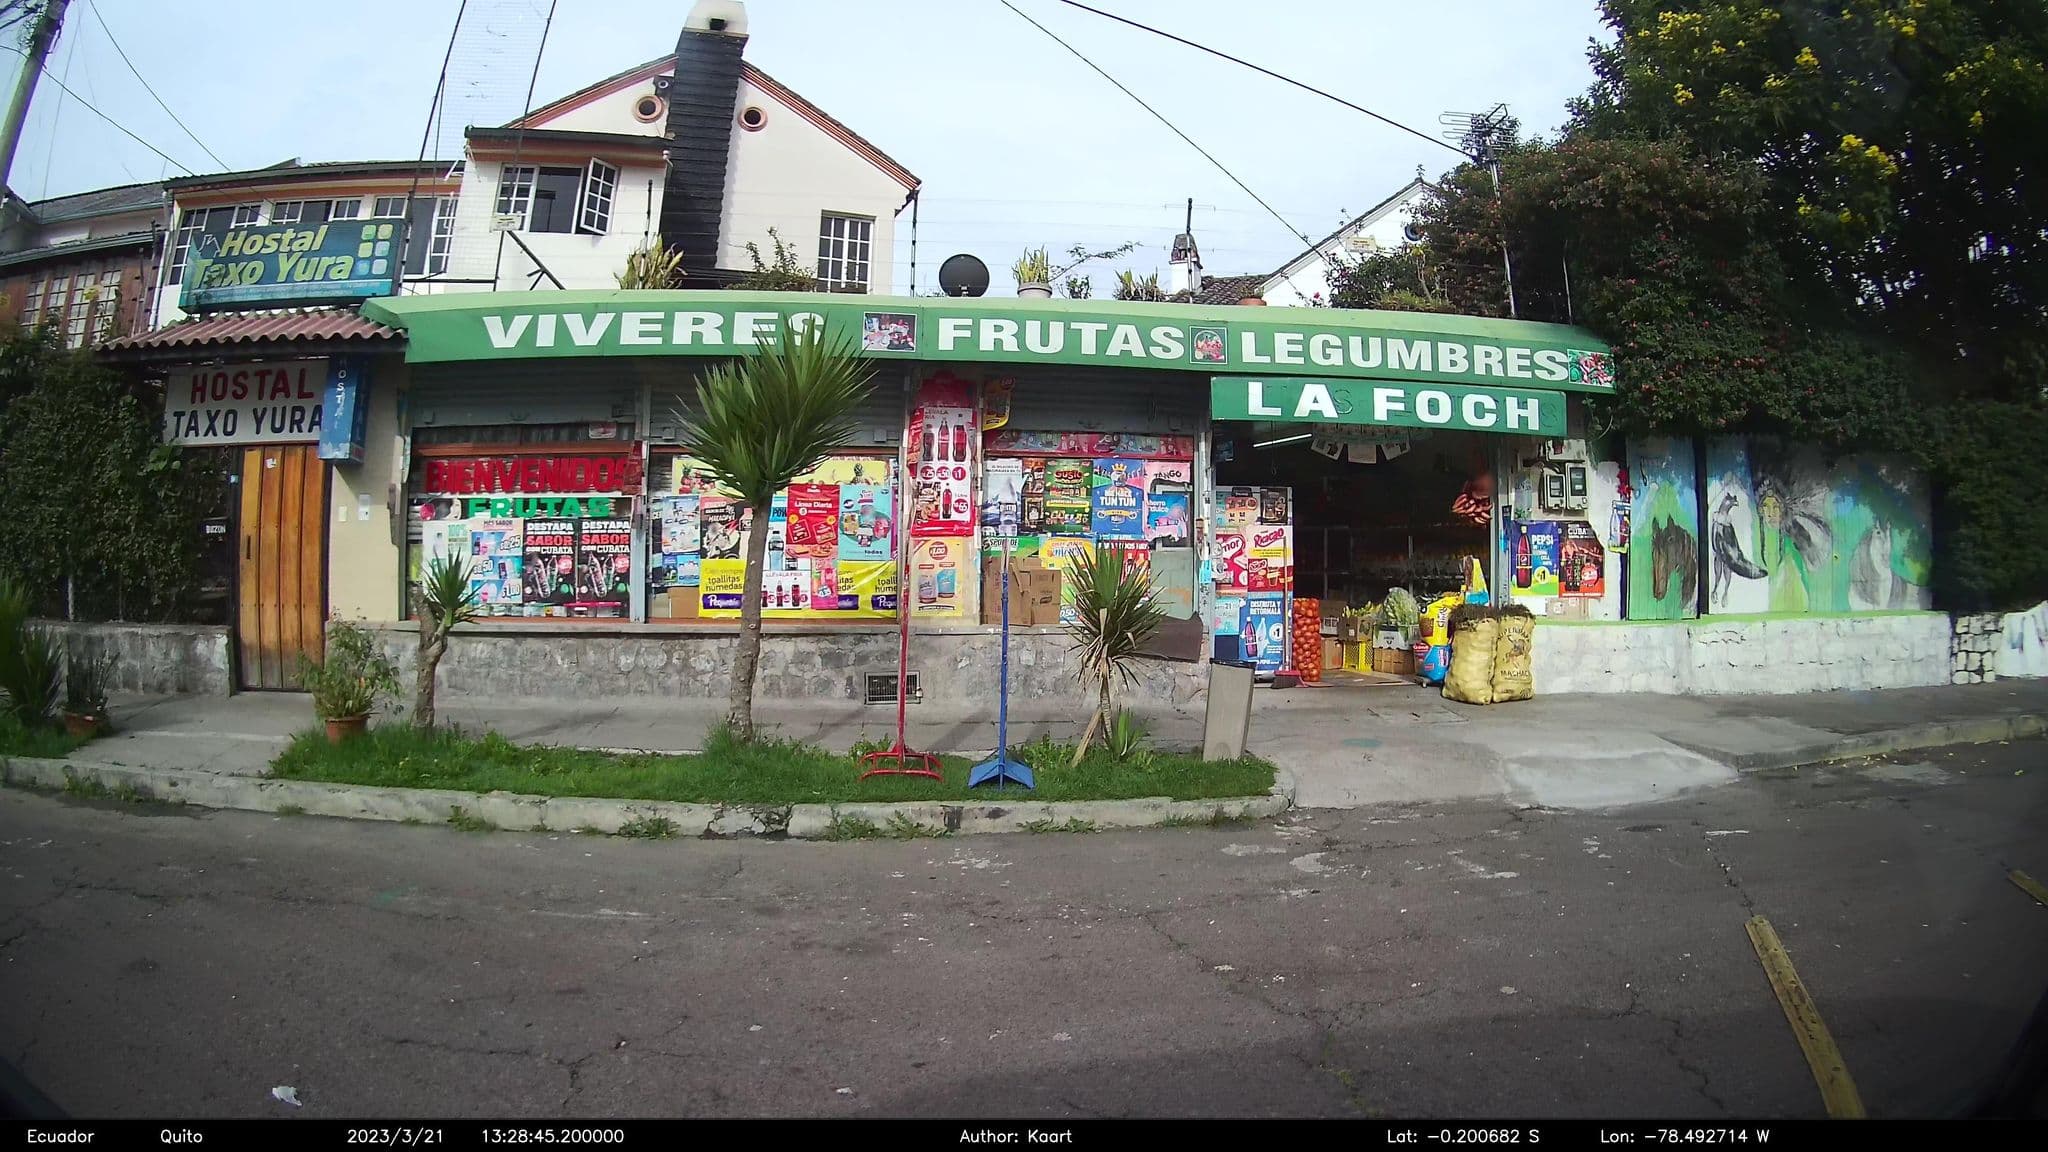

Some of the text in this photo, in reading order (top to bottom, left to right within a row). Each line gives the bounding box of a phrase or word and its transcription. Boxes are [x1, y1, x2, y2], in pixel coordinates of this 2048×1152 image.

[218, 224, 329, 258] Hostal
[191, 251, 354, 290] Taxo Yura
[482, 310, 827, 349] VIVERES
[937, 316, 1185, 359] FRUTAS
[1241, 331, 1570, 382] LEGUMBRES
[190, 367, 315, 405] HOSTAL
[1247, 381, 1540, 431] LA FOCH
[172, 404, 324, 439] TAXO YURA
[1154, 470, 1182, 479] TANGO
[468, 497, 611, 518] FRUTAS
[526, 522, 574, 532] DESTAPA
[582, 520, 631, 530] DESTAPA
[526, 535, 573, 546] SABOR
[581, 534, 630, 545] SABOR
[1531, 534, 1554, 545] PEPSI
[708, 574, 741, 585] toallitas
